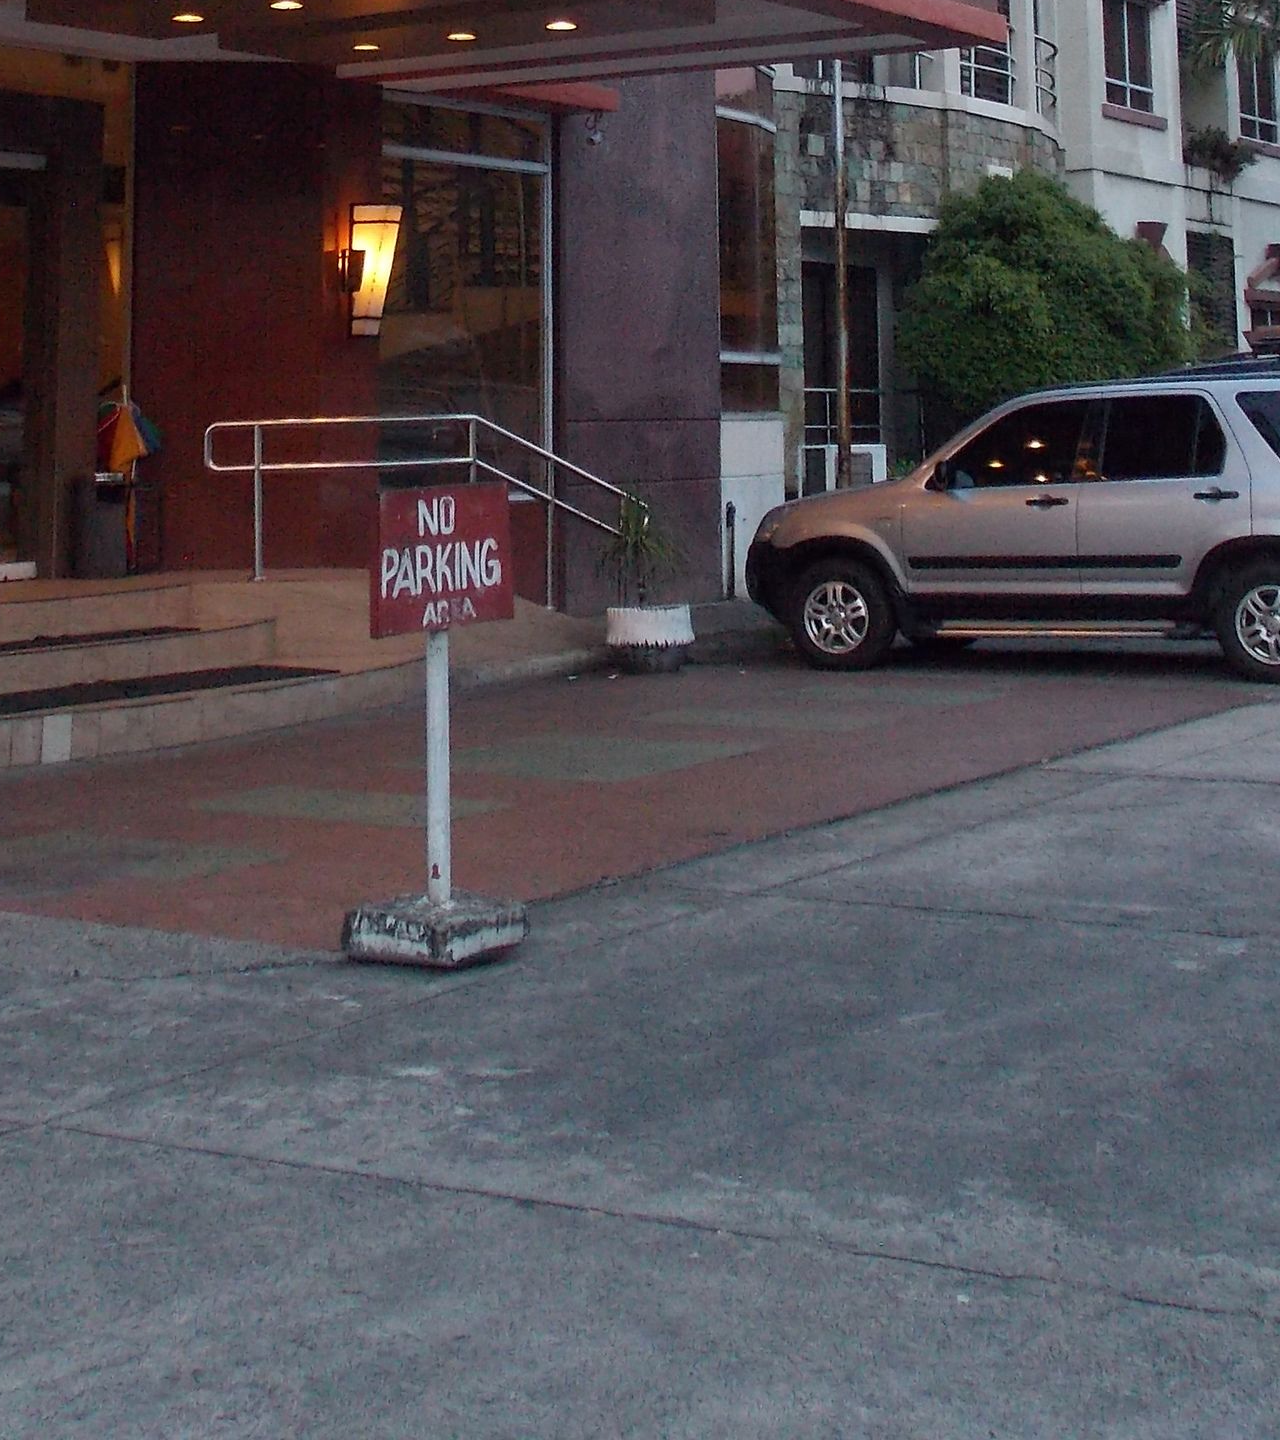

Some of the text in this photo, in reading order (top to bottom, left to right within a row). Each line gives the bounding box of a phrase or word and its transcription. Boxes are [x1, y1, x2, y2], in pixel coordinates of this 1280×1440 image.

[418, 496, 455, 536] NO
[381, 539, 502, 599] PARKING
[423, 597, 477, 627] ARA
